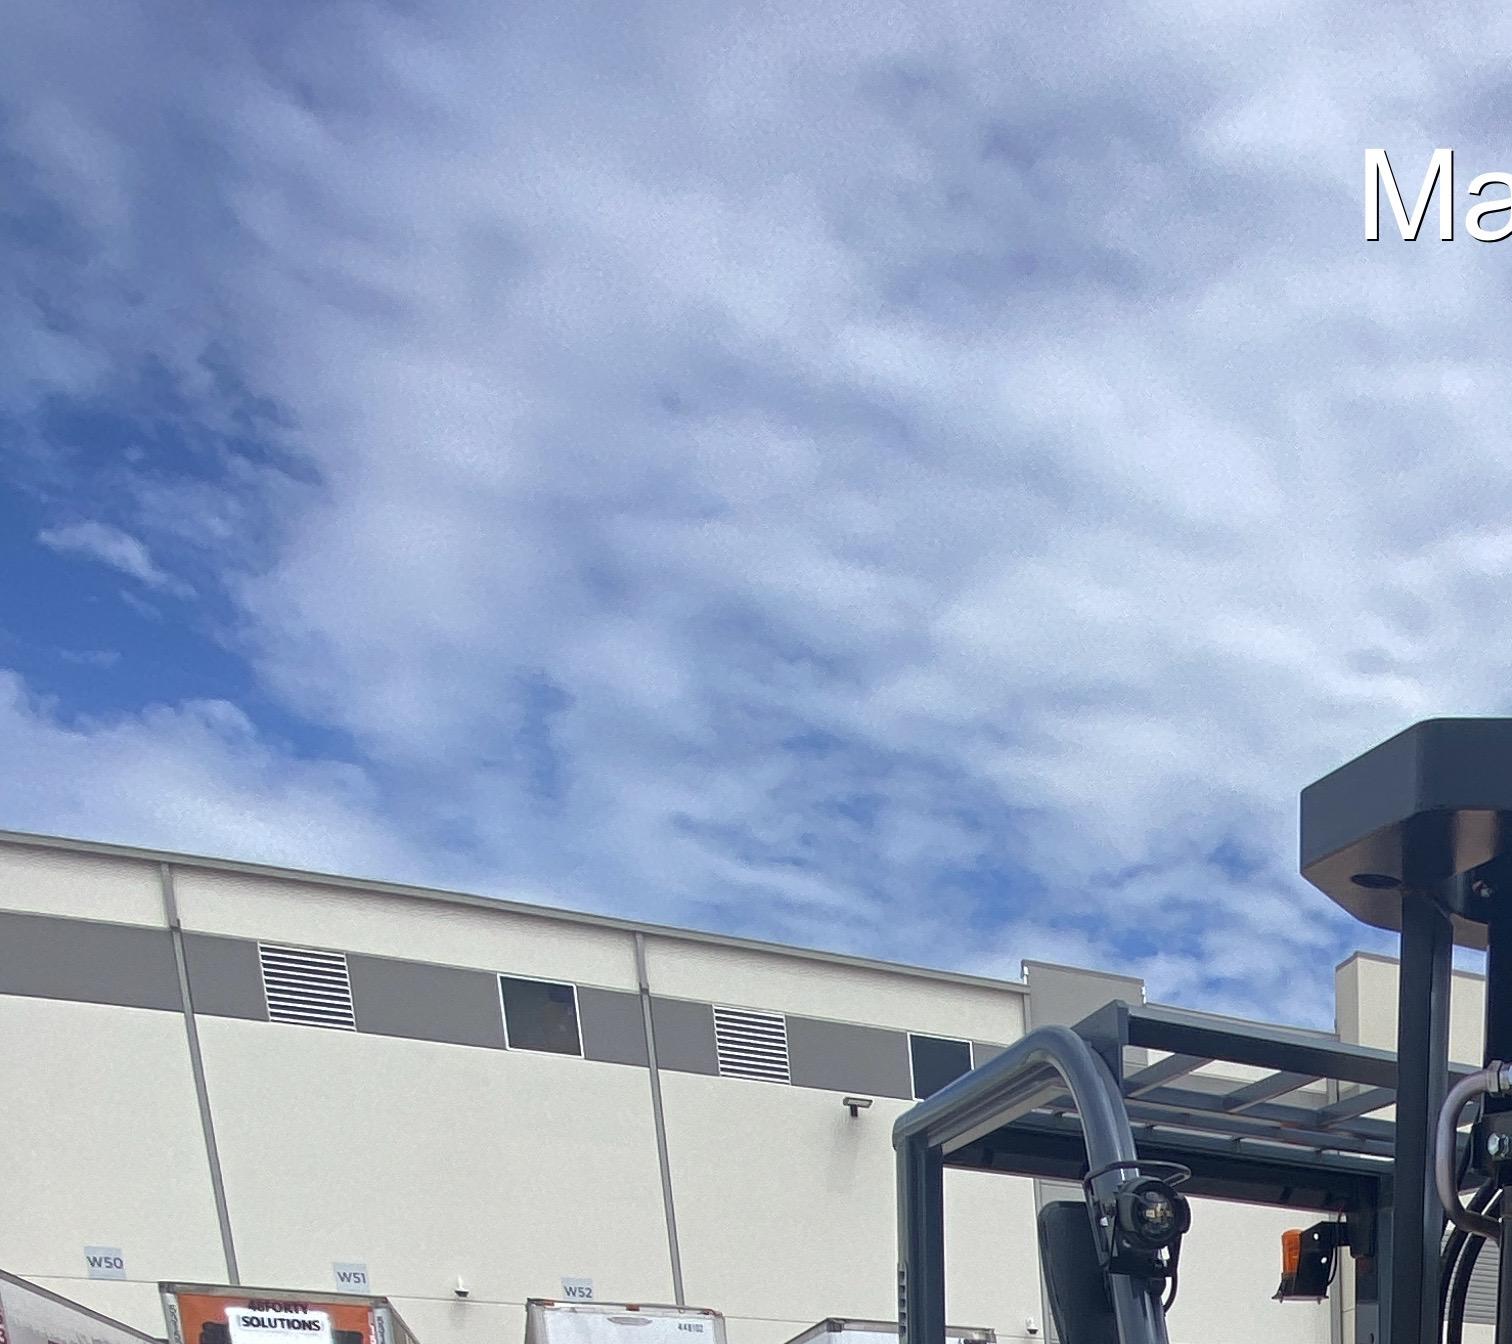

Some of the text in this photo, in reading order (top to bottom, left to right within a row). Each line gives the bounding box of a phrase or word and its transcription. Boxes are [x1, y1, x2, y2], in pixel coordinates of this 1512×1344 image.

[86, 1256, 124, 1269] W50
[337, 1271, 366, 1284] W51
[564, 1286, 592, 1298] W52
[241, 1315, 321, 1331] SOLUTIONS
